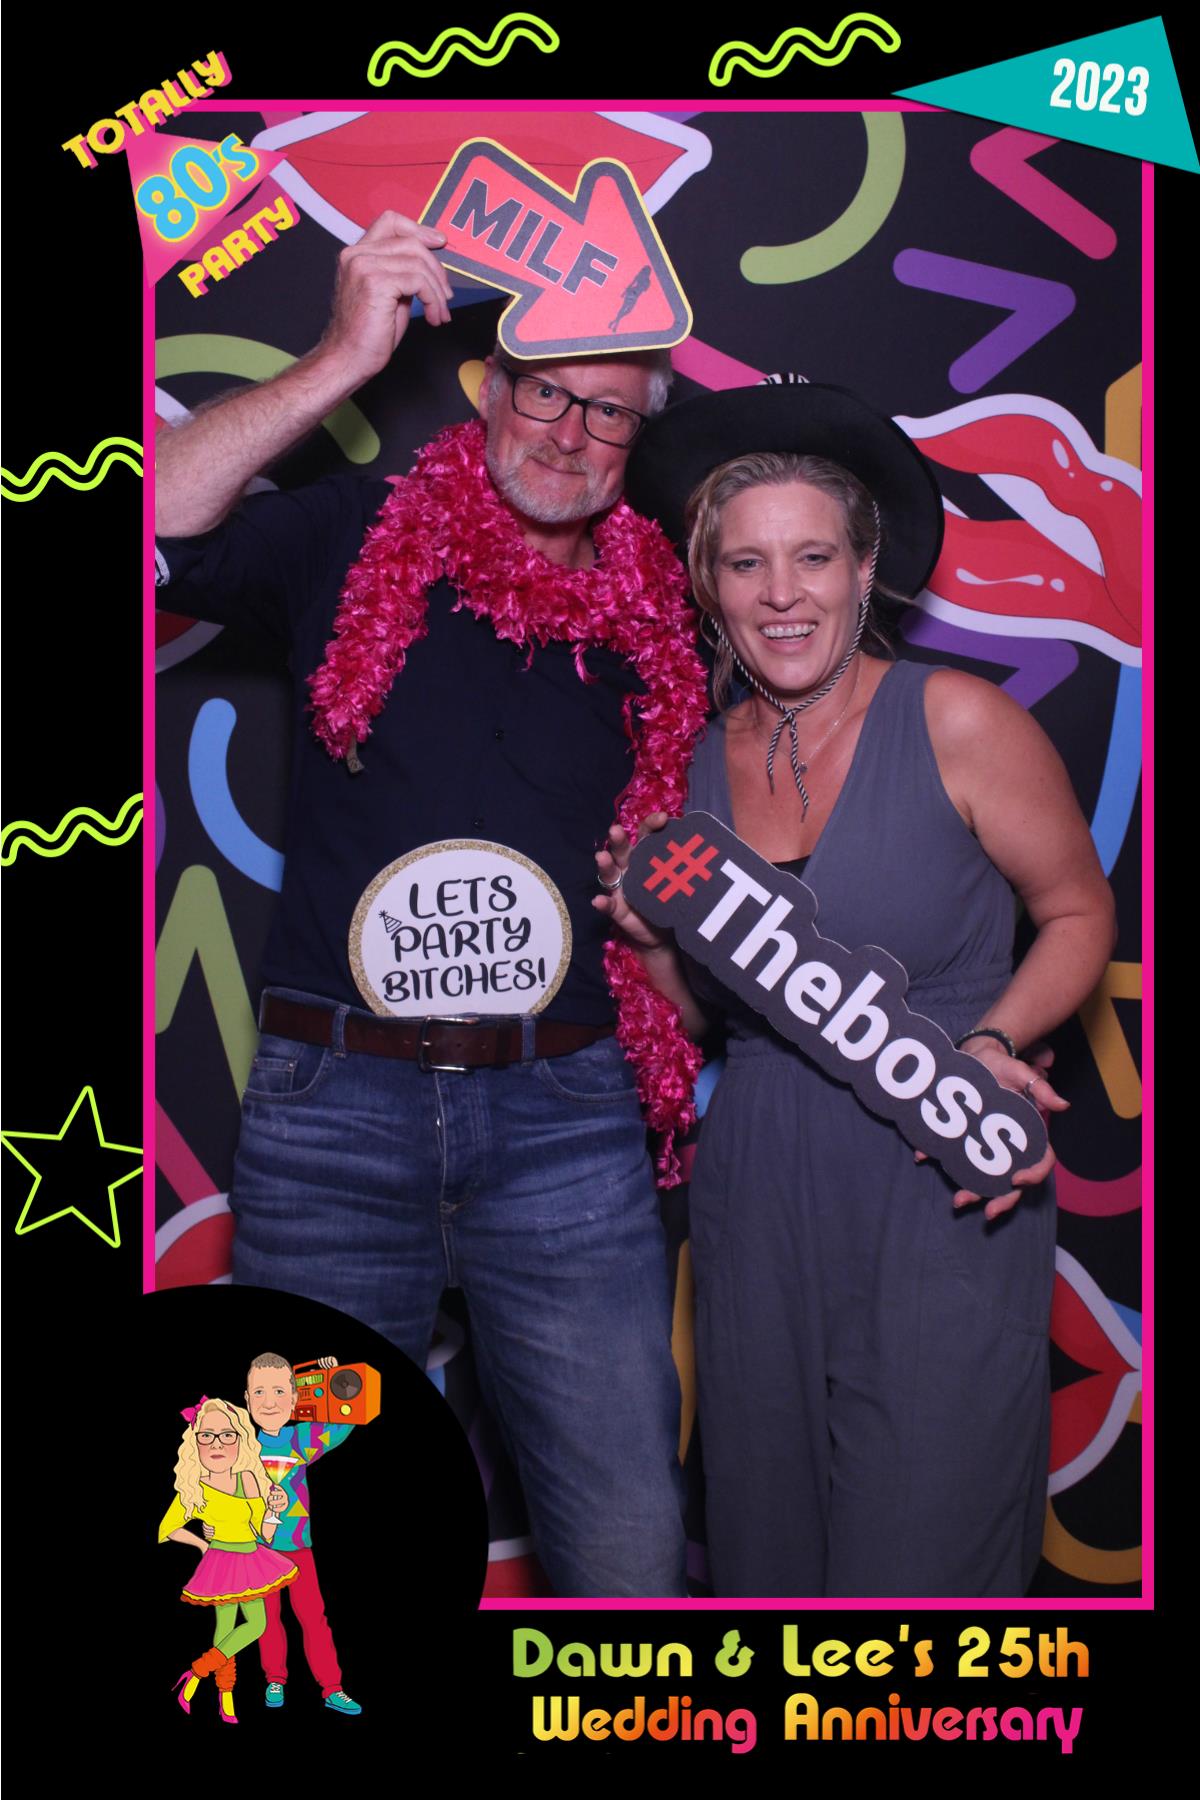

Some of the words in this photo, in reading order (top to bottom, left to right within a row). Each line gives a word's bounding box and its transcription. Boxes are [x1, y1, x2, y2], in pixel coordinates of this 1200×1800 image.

[450, 177, 619, 295] MILF
[409, 874, 518, 919] LETS
[390, 916, 532, 963] PARTY
[381, 957, 547, 1003] BITCHES!
[642, 833, 1028, 1176] #Theboss
